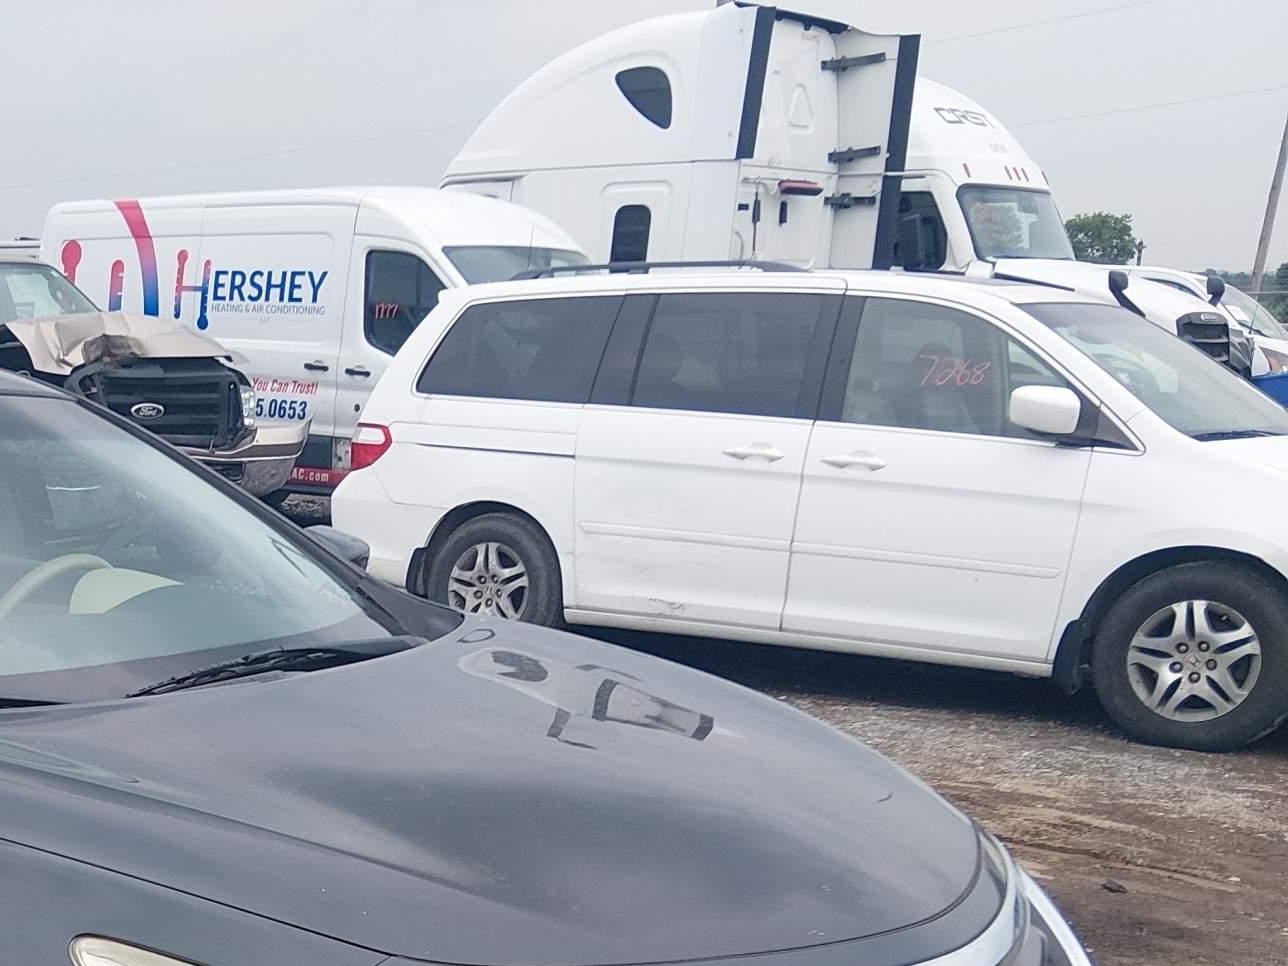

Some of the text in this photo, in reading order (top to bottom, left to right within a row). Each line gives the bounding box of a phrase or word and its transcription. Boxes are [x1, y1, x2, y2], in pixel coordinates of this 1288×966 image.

[173, 249, 329, 331] HERSHEY
[211, 303, 244, 313] HEATING
[251, 304, 264, 314] AIR
[265, 304, 326, 316] CONDITIONING
[252, 377, 319, 395] You Can Trust!
[289, 467, 329, 482] AC.com
